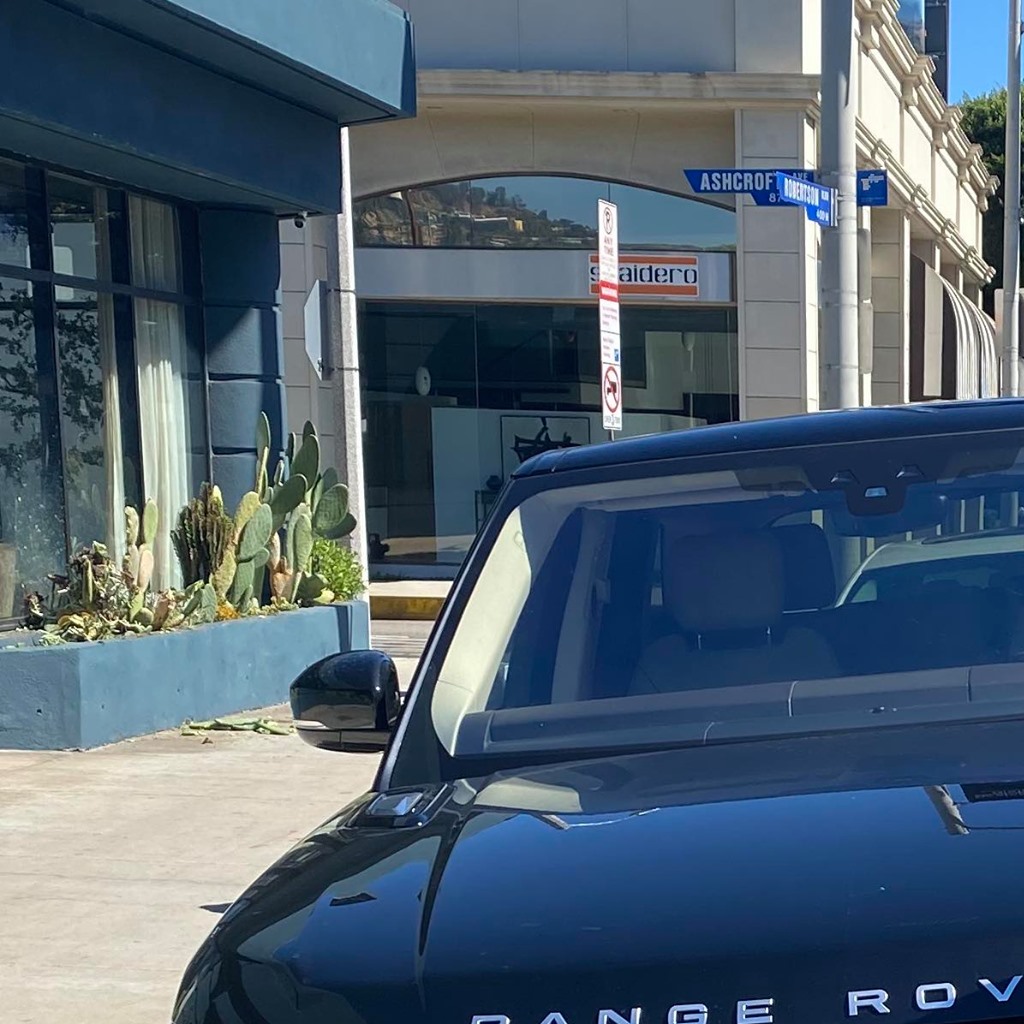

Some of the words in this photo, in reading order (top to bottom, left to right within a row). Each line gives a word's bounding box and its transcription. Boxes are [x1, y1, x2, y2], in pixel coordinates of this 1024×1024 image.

[700, 172, 779, 190] ASHCROF
[784, 177, 819, 207] ROBERTSON
[590, 264, 698, 284] saidero
